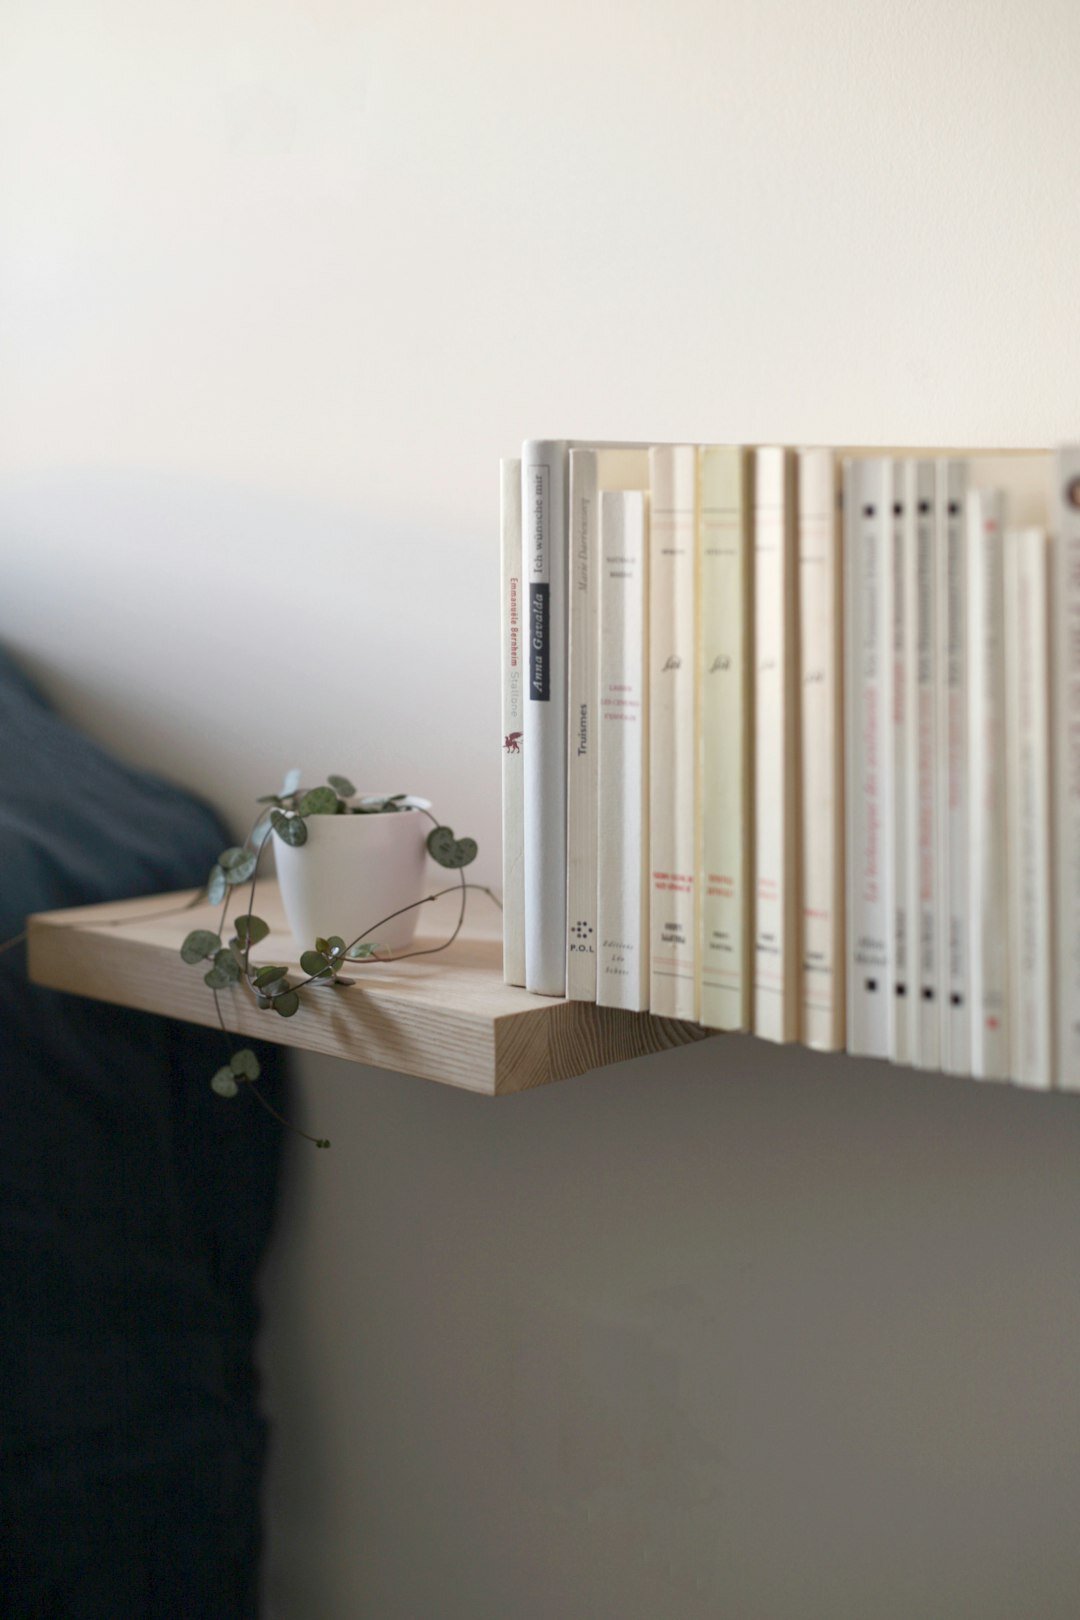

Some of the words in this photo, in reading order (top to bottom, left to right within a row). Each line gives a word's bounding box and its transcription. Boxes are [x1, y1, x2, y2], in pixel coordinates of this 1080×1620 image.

[535, 474, 543, 496] mir
[533, 499, 543, 551] wünsche
[533, 554, 543, 573] Ich
[578, 563, 588, 593] Marie
[510, 577, 519, 625] Emmanuèle
[532, 593, 544, 650] Gavalda
[510, 627, 519, 667] Bernheim
[510, 671, 520, 717] Stallone
[532, 656, 543, 693] Anna
[578, 704, 587, 756] Truismes
[570, 944, 594, 953] P.O.L
